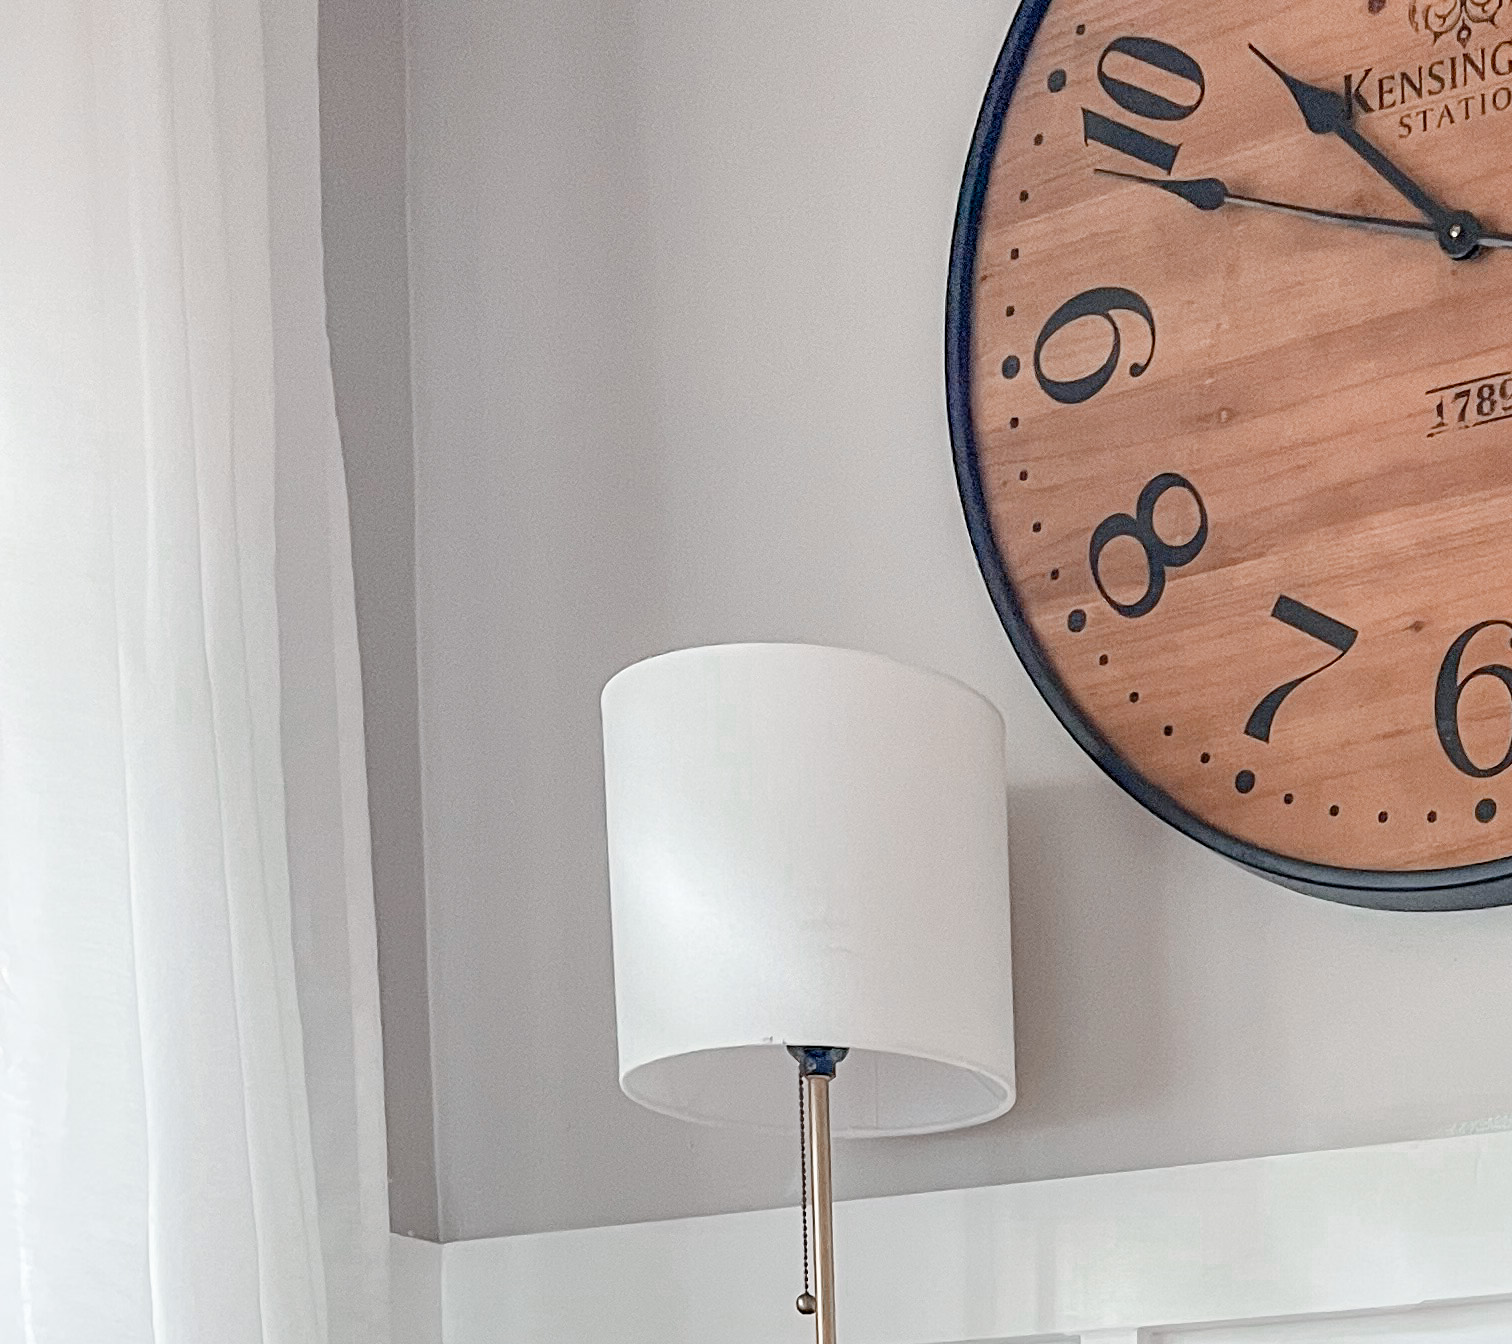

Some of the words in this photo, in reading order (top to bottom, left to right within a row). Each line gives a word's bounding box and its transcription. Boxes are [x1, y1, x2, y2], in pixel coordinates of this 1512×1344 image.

[1081, 36, 1205, 175] 10
[1033, 286, 1156, 403] 9
[1089, 473, 1209, 619] 8
[1245, 595, 1358, 743] 7
